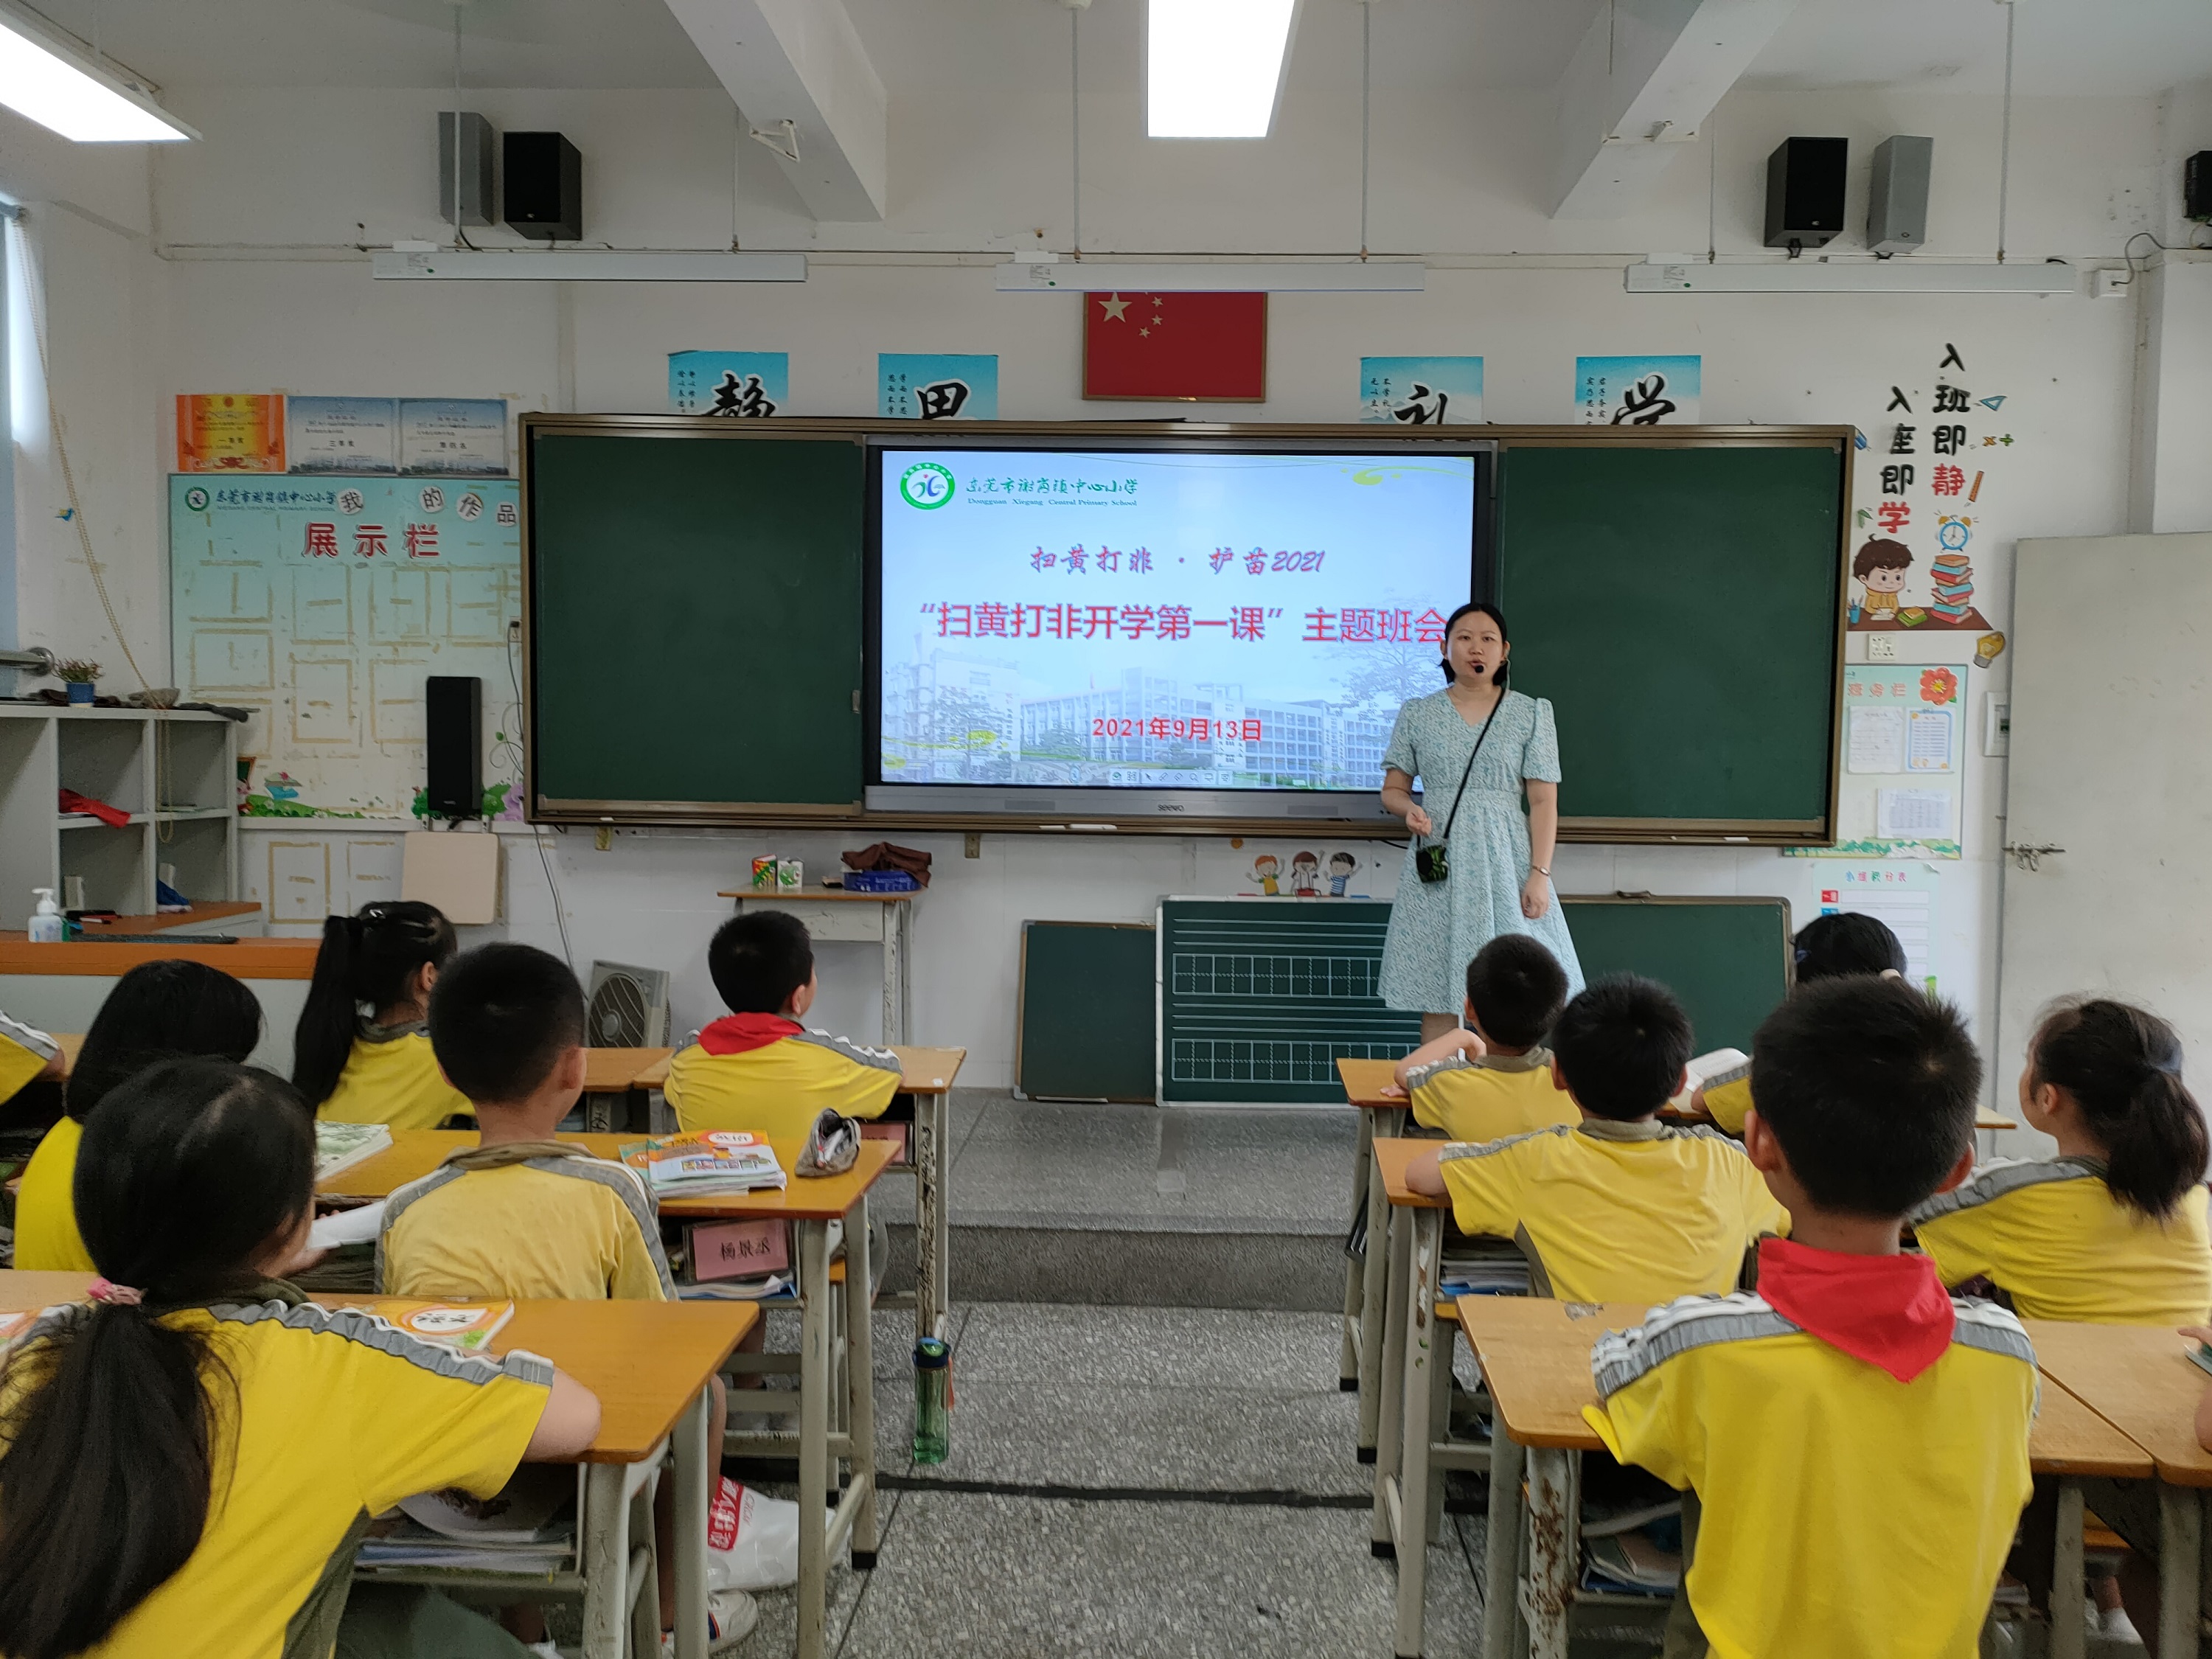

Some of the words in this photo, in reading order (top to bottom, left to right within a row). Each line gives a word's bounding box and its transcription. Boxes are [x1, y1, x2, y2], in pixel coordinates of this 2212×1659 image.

[1932, 343, 1971, 496] 入班即静
[1878, 386, 1916, 534] 入座即学
[966, 477, 1138, 494] 东莞市谢岗镇中心小学
[302, 523, 440, 558] 展示栏
[1093, 717, 1262, 742] 2021年9月13日
[1158, 804, 1185, 812] seewo
